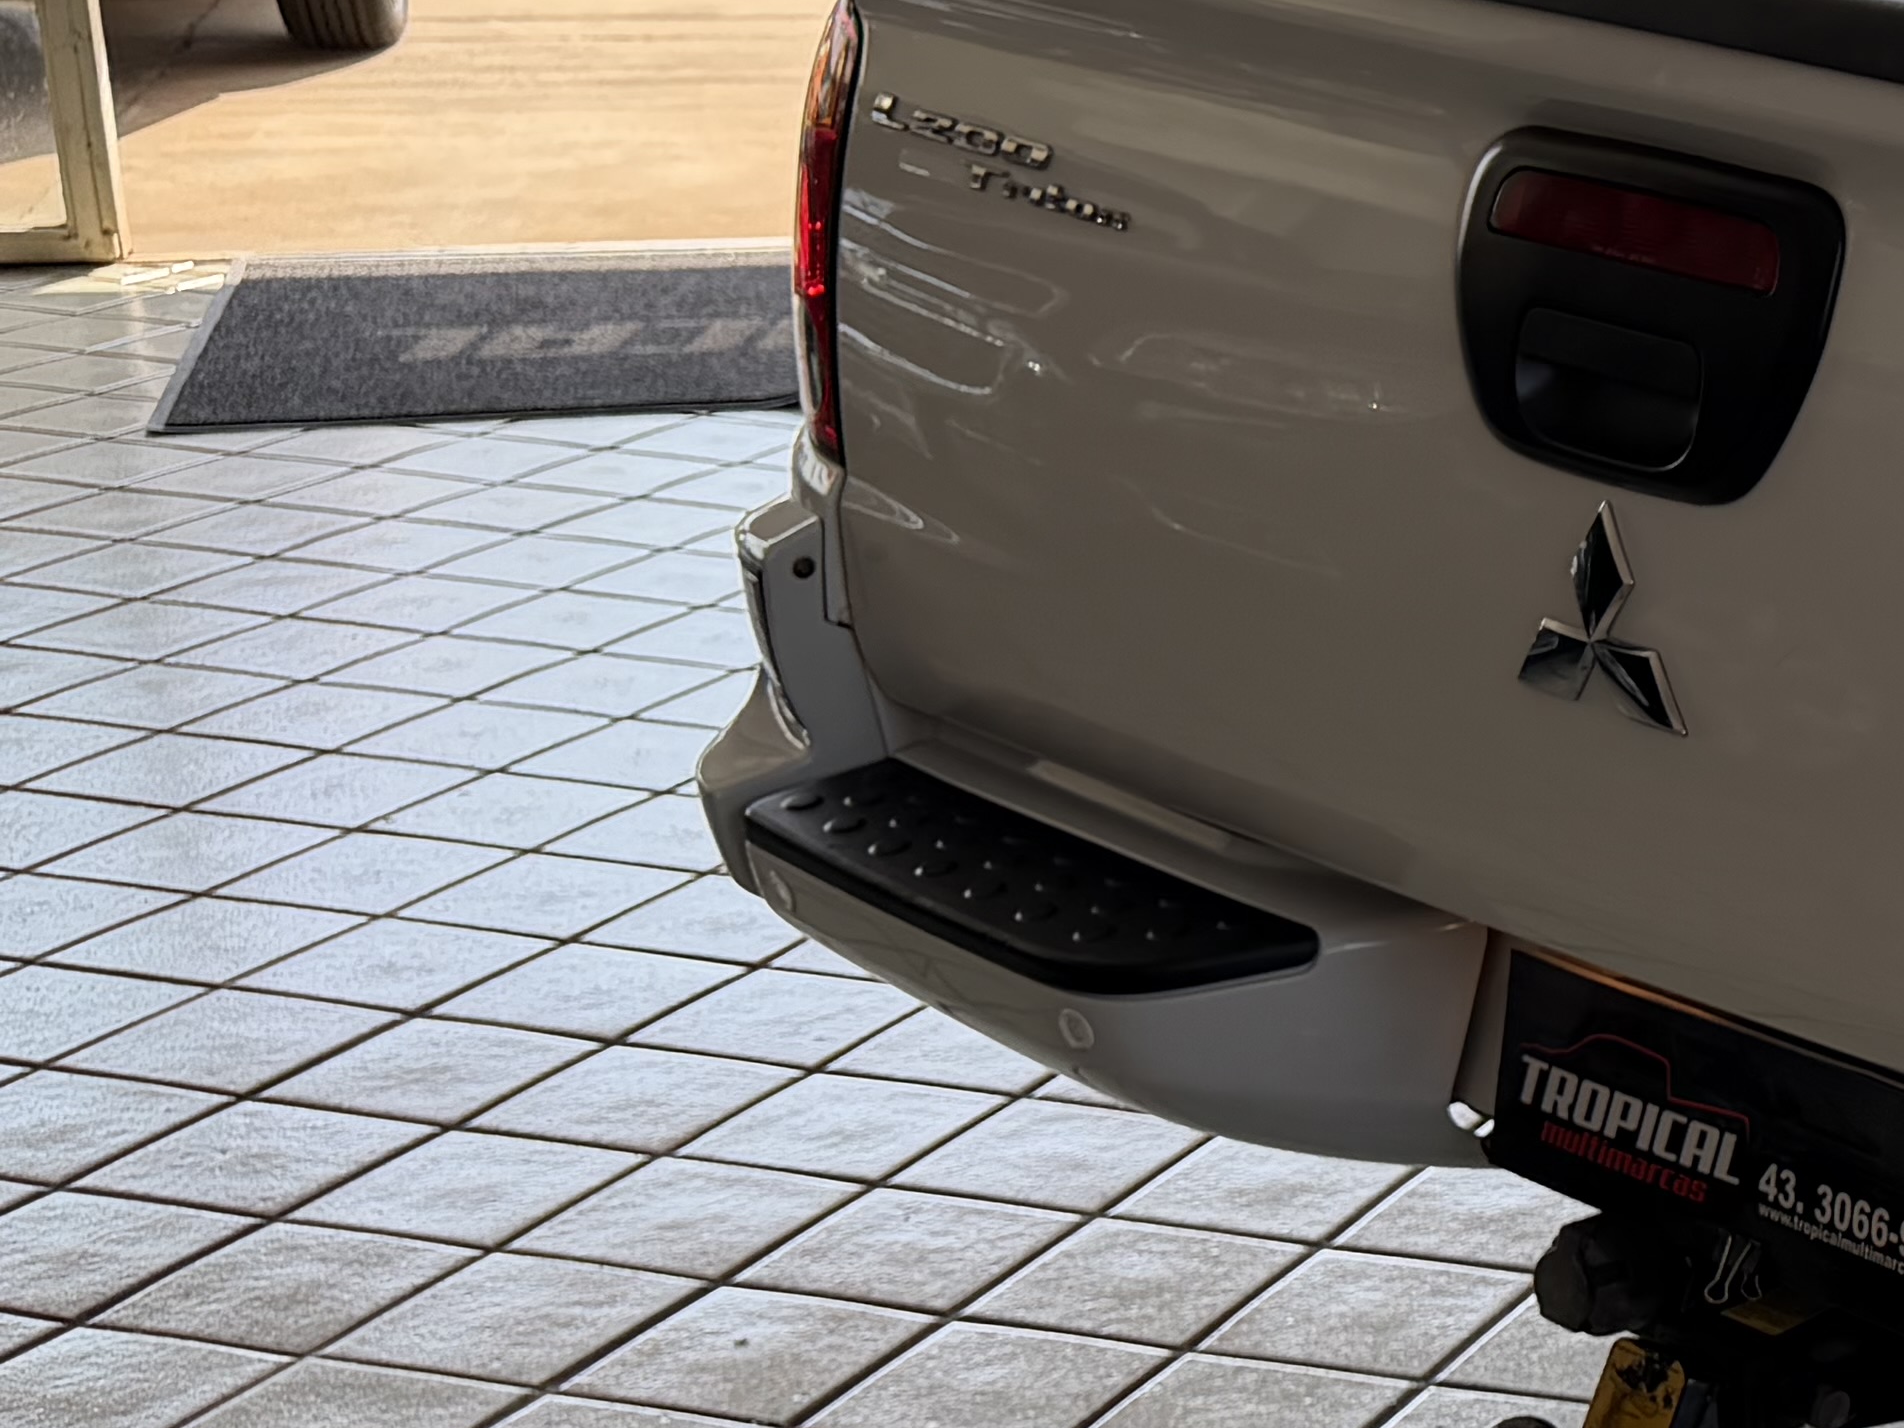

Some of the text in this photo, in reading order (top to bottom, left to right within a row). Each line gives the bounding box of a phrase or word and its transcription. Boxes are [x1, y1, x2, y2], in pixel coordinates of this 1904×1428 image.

[871, 91, 1053, 171] L200
[1520, 1053, 1741, 1186] TROPICAL
[1540, 1121, 1708, 1203] multimarcas
[1758, 1163, 1805, 1215] 43.
